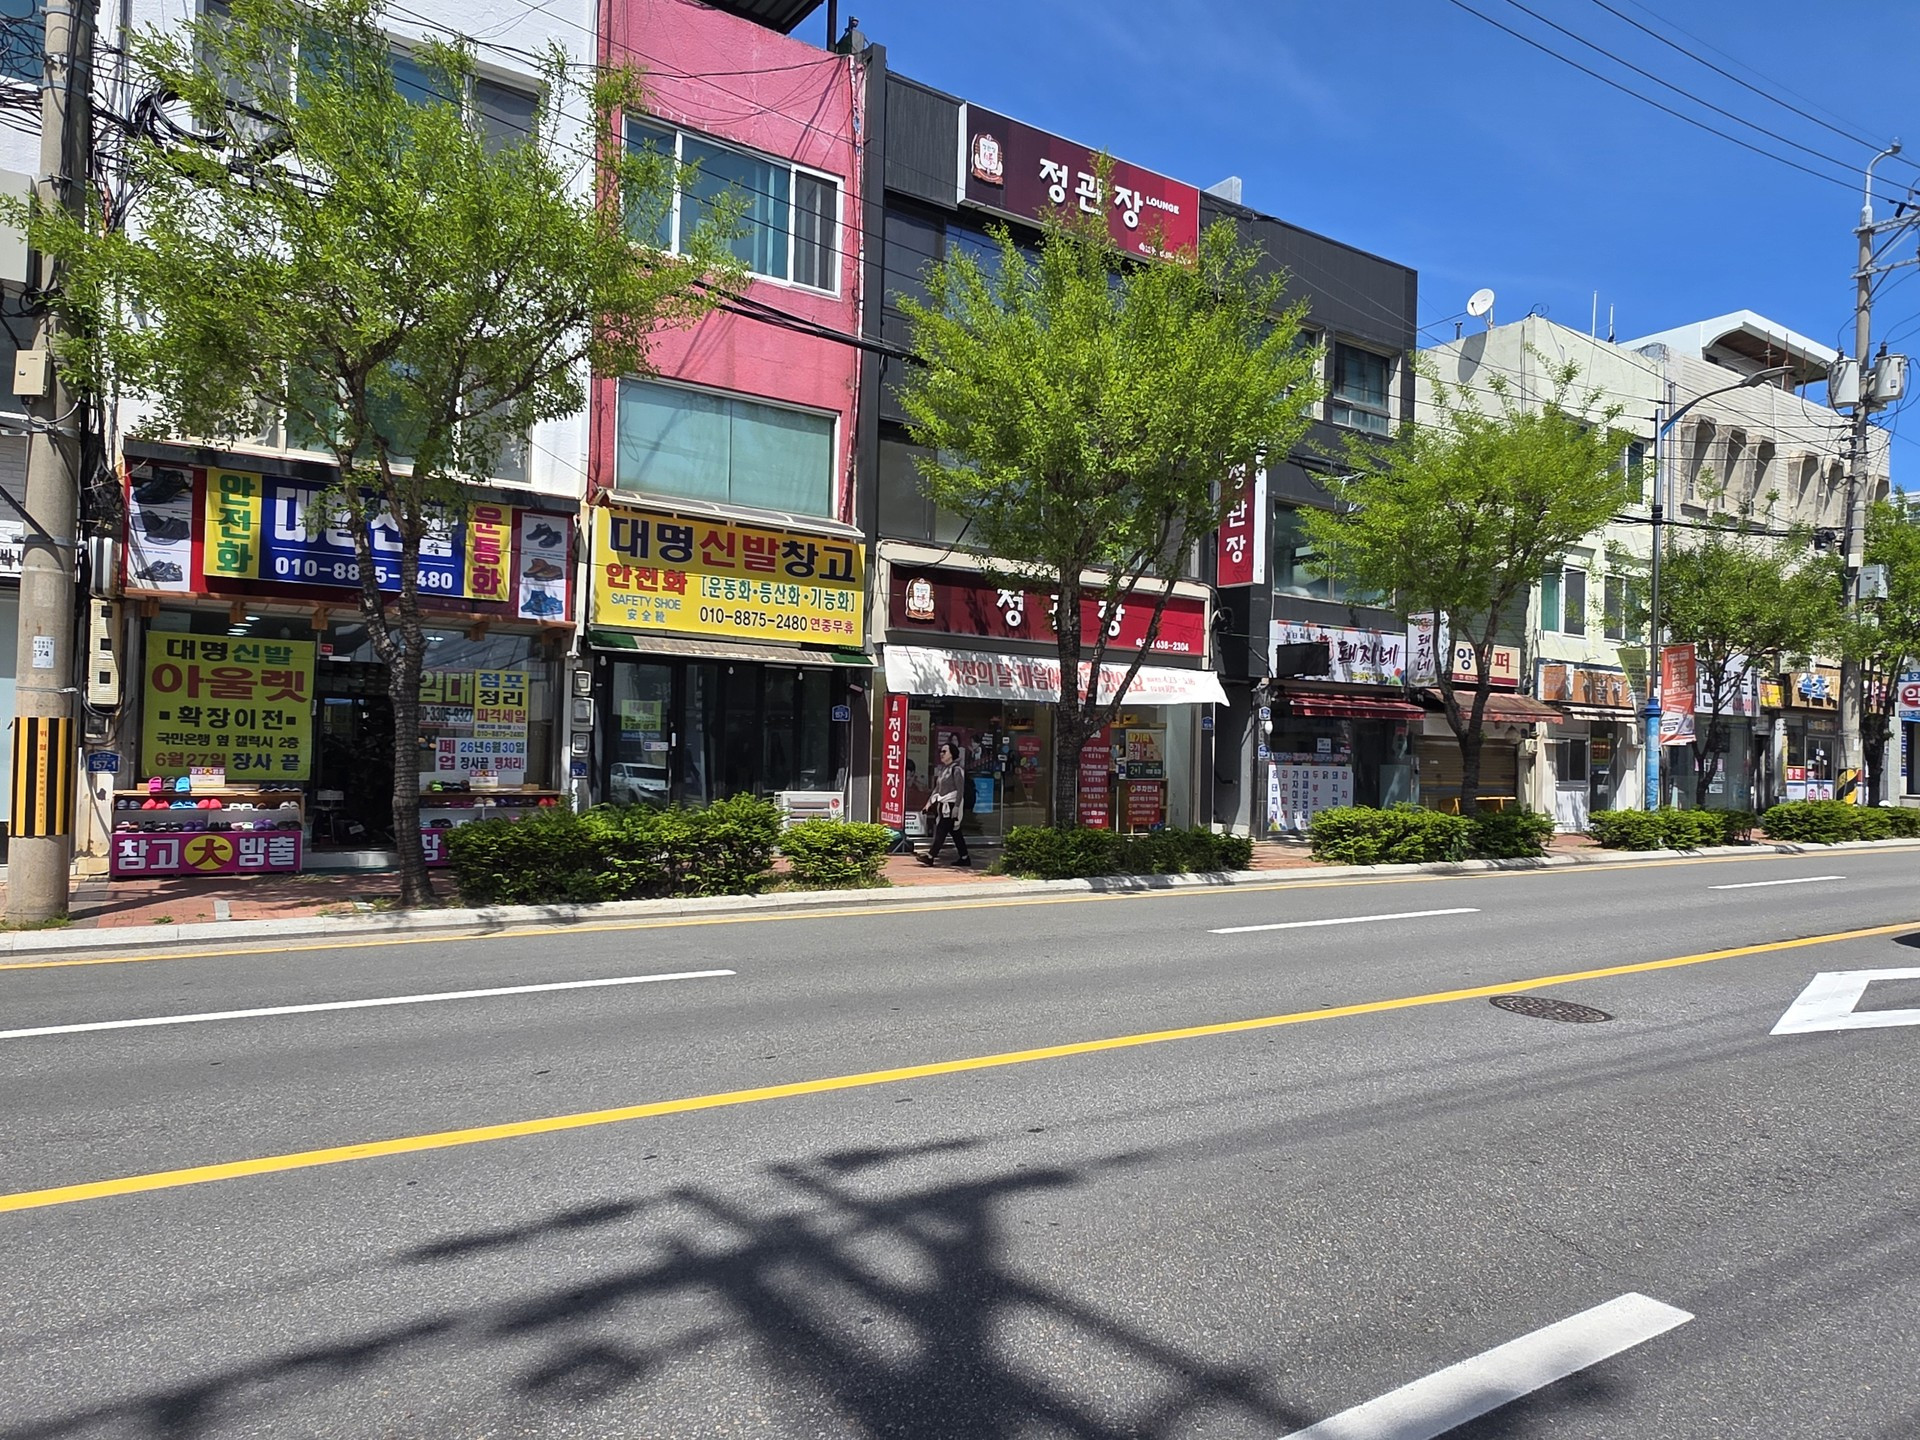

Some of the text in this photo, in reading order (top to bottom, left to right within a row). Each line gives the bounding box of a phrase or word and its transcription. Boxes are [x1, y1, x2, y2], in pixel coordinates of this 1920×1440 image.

[1039, 157, 1143, 228] 정관장
[1145, 195, 1180, 215] LOUNGE
[216, 474, 254, 573] 안전화
[472, 506, 503, 595] 운동화
[610, 516, 856, 583] 대명신발창고
[275, 556, 453, 590] 010-885-480
[606, 562, 688, 595] 안전화
[611, 593, 681, 610] SAFETY SHOE
[997, 588, 1126, 637] 정장
[700, 606, 808, 631] 010-8875-2480
[810, 618, 854, 635] 연중무휴
[166, 638, 293, 665] 대명신발
[1337, 640, 1400, 668] 돼지네
[1417, 634, 1432, 671] 돼지네
[1456, 648, 1510, 674] 양퍼
[151, 663, 308, 703] 아울렛
[419, 669, 474, 705] 임대
[479, 672, 525, 690] 점포
[478, 690, 523, 707] 정리
[177, 705, 284, 730] 확장이전
[477, 709, 526, 723] 파격세일
[156, 732, 211, 746] 국민은행
[216, 734, 230, 748] 옆
[279, 737, 300, 748] 2층
[460, 741, 525, 754] 26년6월30일
[92, 760, 116, 769] 157-1
[155, 752, 301, 771] 6월27일 장사 끝
[438, 739, 456, 771] 폐업
[460, 756, 489, 770] 장사끝
[886, 717, 901, 799] 정관장
